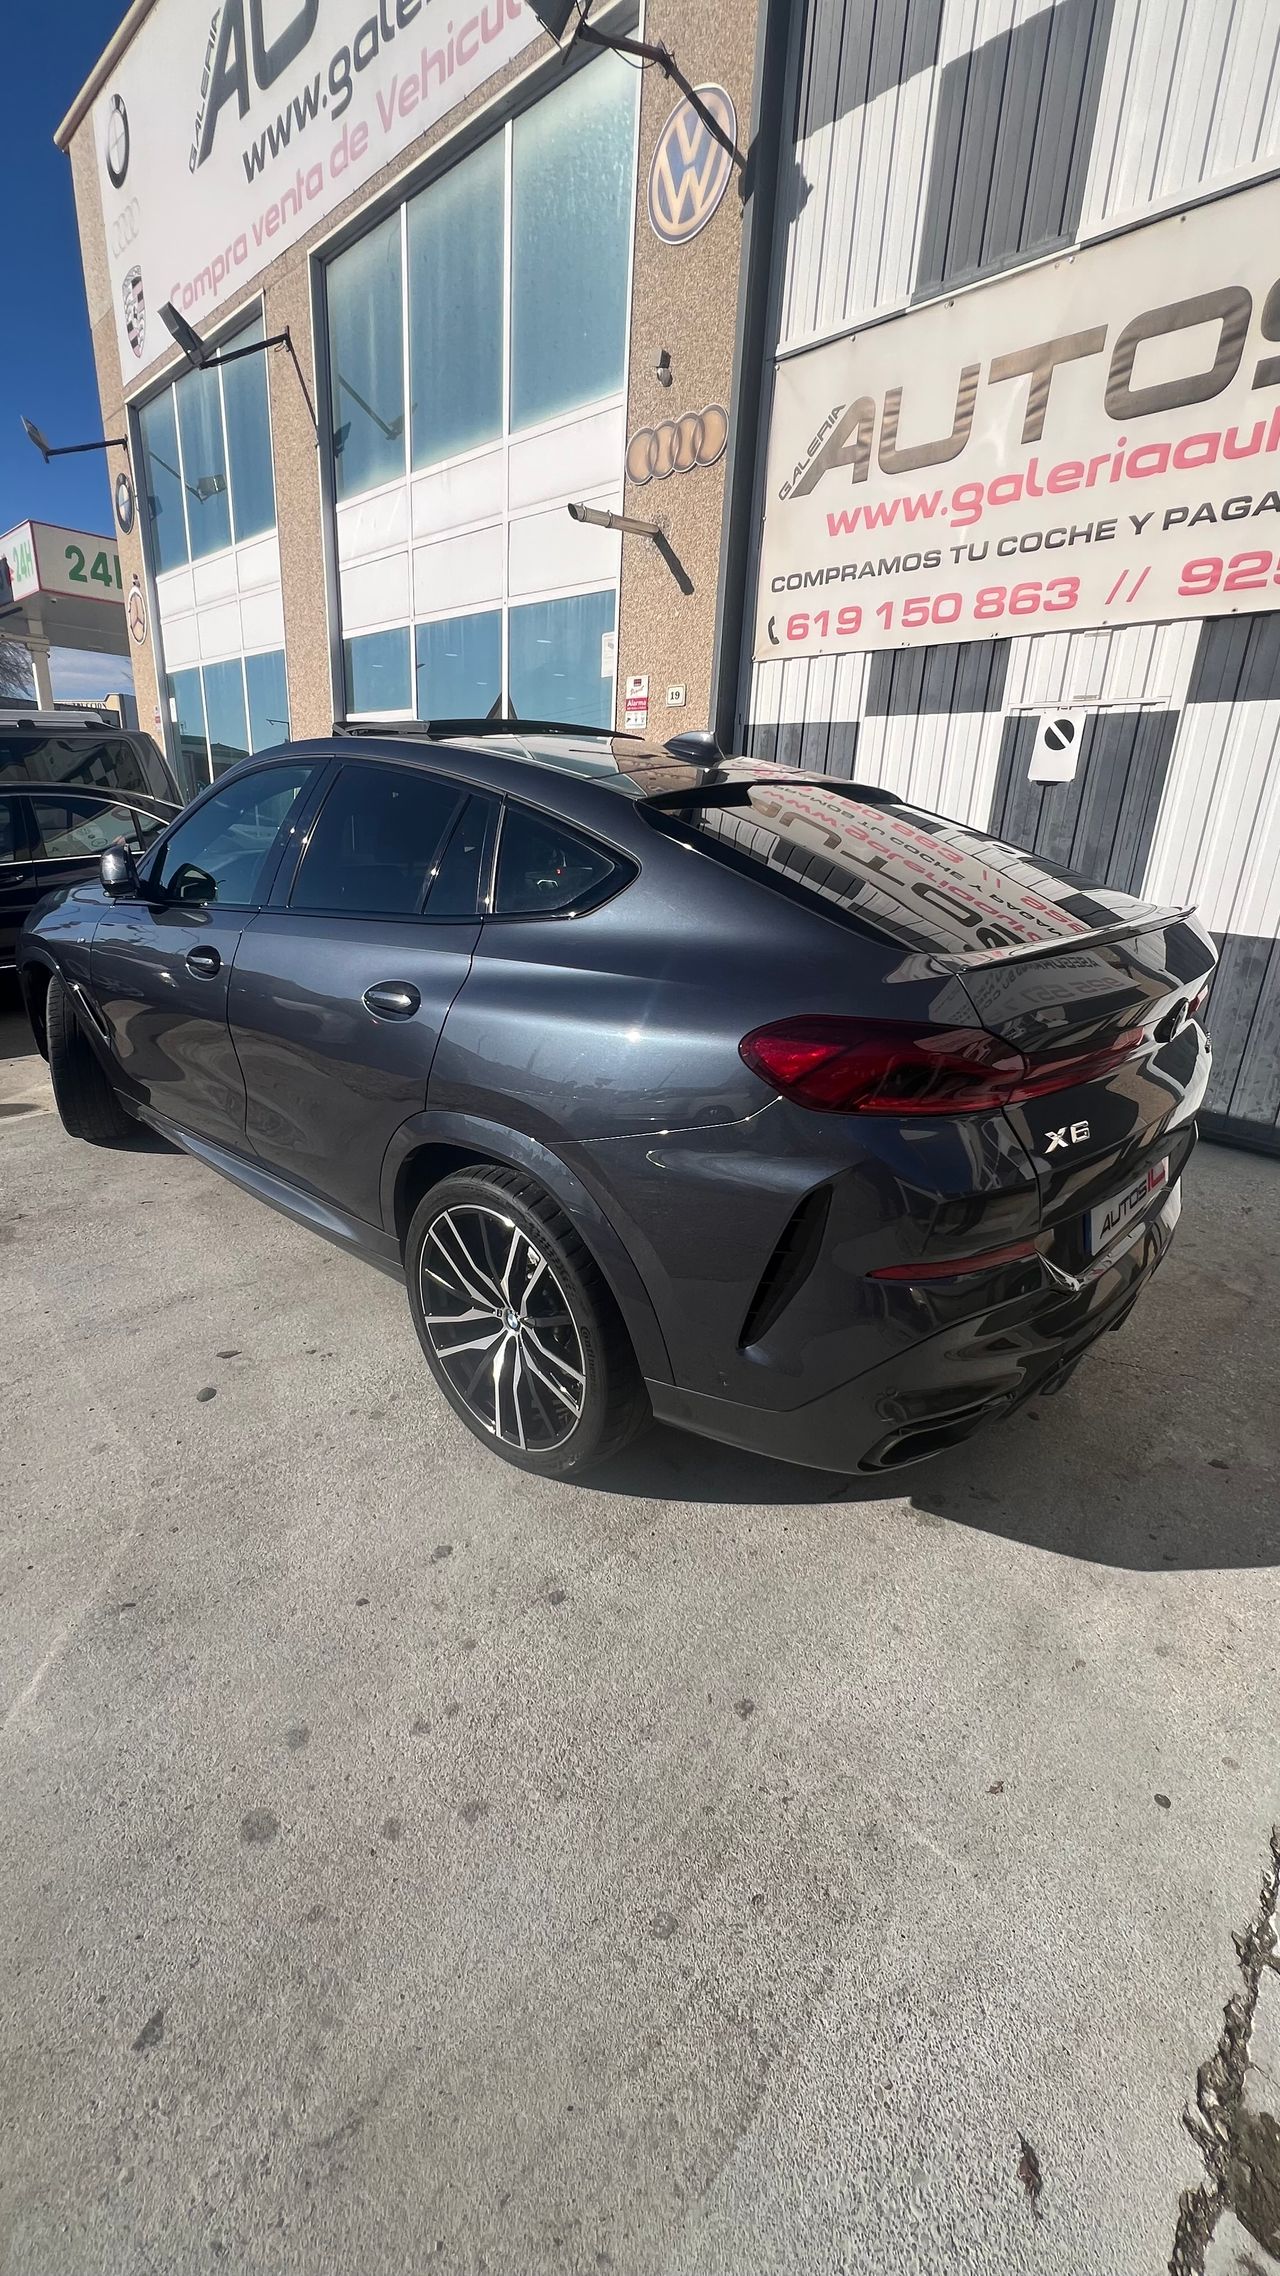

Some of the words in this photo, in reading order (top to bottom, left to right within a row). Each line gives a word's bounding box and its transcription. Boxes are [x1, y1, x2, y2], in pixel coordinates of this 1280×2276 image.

[252, 162, 323, 246] venta
[330, 121, 369, 179] de
[789, 278, 1280, 499] AUTO
[778, 403, 847, 501] GALERIA
[771, 549, 942, 593] COMPRAMOS
[950, 540, 990, 565] TU
[997, 518, 1119, 557] COCHE
[1128, 511, 1156, 536] Y
[786, 605, 863, 641] 619
[876, 592, 963, 631] 150
[974, 576, 1081, 620] 863
[1178, 550, 1280, 597] 92
[670, 690, 681, 701] 19
[1044, 1120, 1091, 1154] X6
